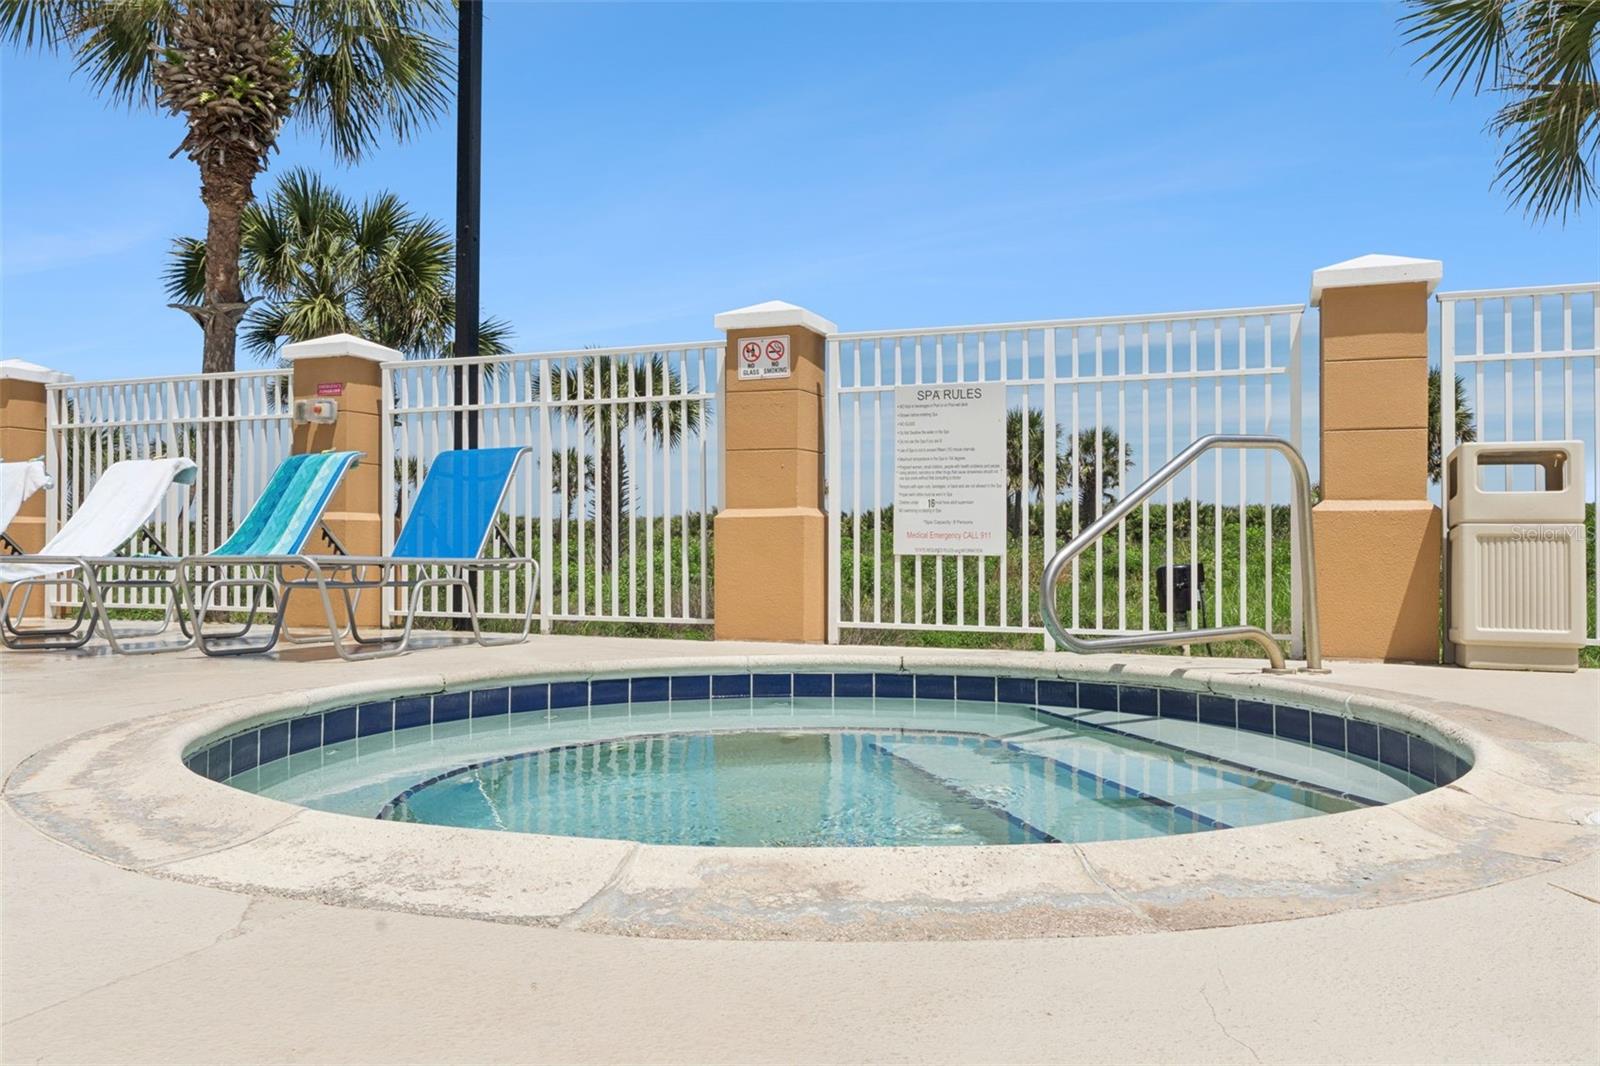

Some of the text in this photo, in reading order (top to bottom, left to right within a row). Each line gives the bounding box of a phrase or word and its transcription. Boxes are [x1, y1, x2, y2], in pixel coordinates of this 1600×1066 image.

[917, 388, 982, 400] SPA RULES
[906, 530, 992, 541] Medical Emergency CALL 911
